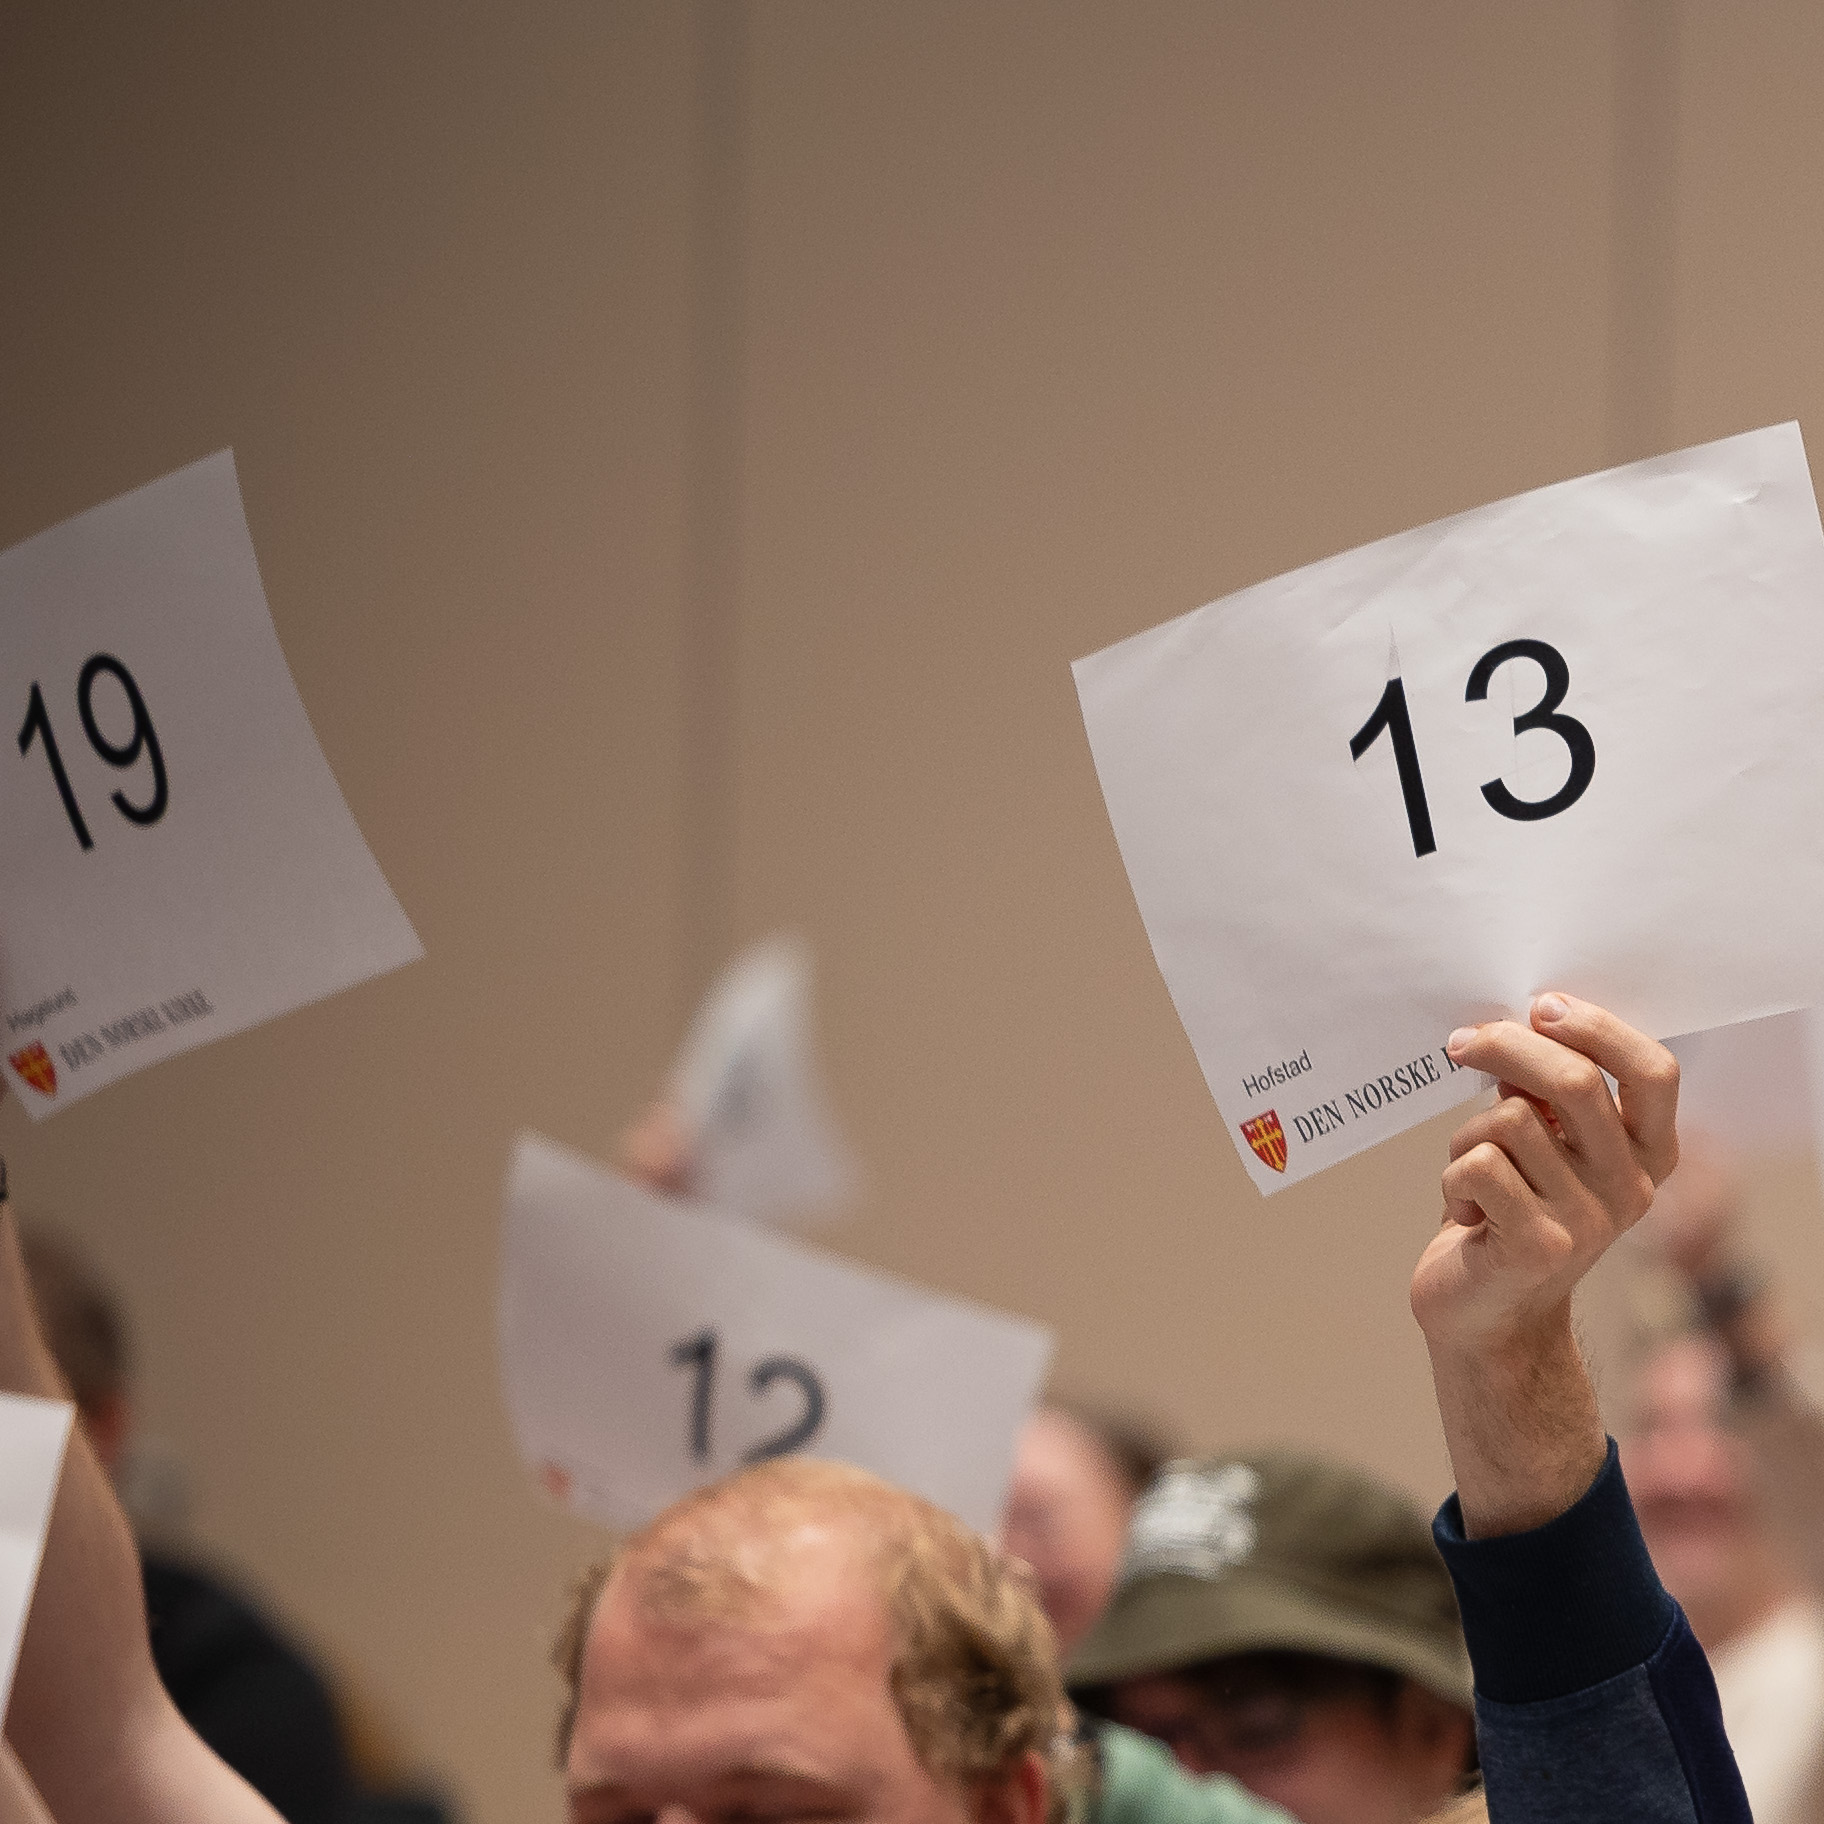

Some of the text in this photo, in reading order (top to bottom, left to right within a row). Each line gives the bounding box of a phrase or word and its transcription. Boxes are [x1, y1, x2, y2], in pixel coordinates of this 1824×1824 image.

[17, 651, 169, 852] 19
[1350, 639, 1596, 858] 13
[1242, 1048, 1314, 1099] Hofstad
[1292, 1099, 1346, 1144] DEN
[1344, 1054, 1441, 1119] NORSKE
[667, 1328, 827, 1470] 12
